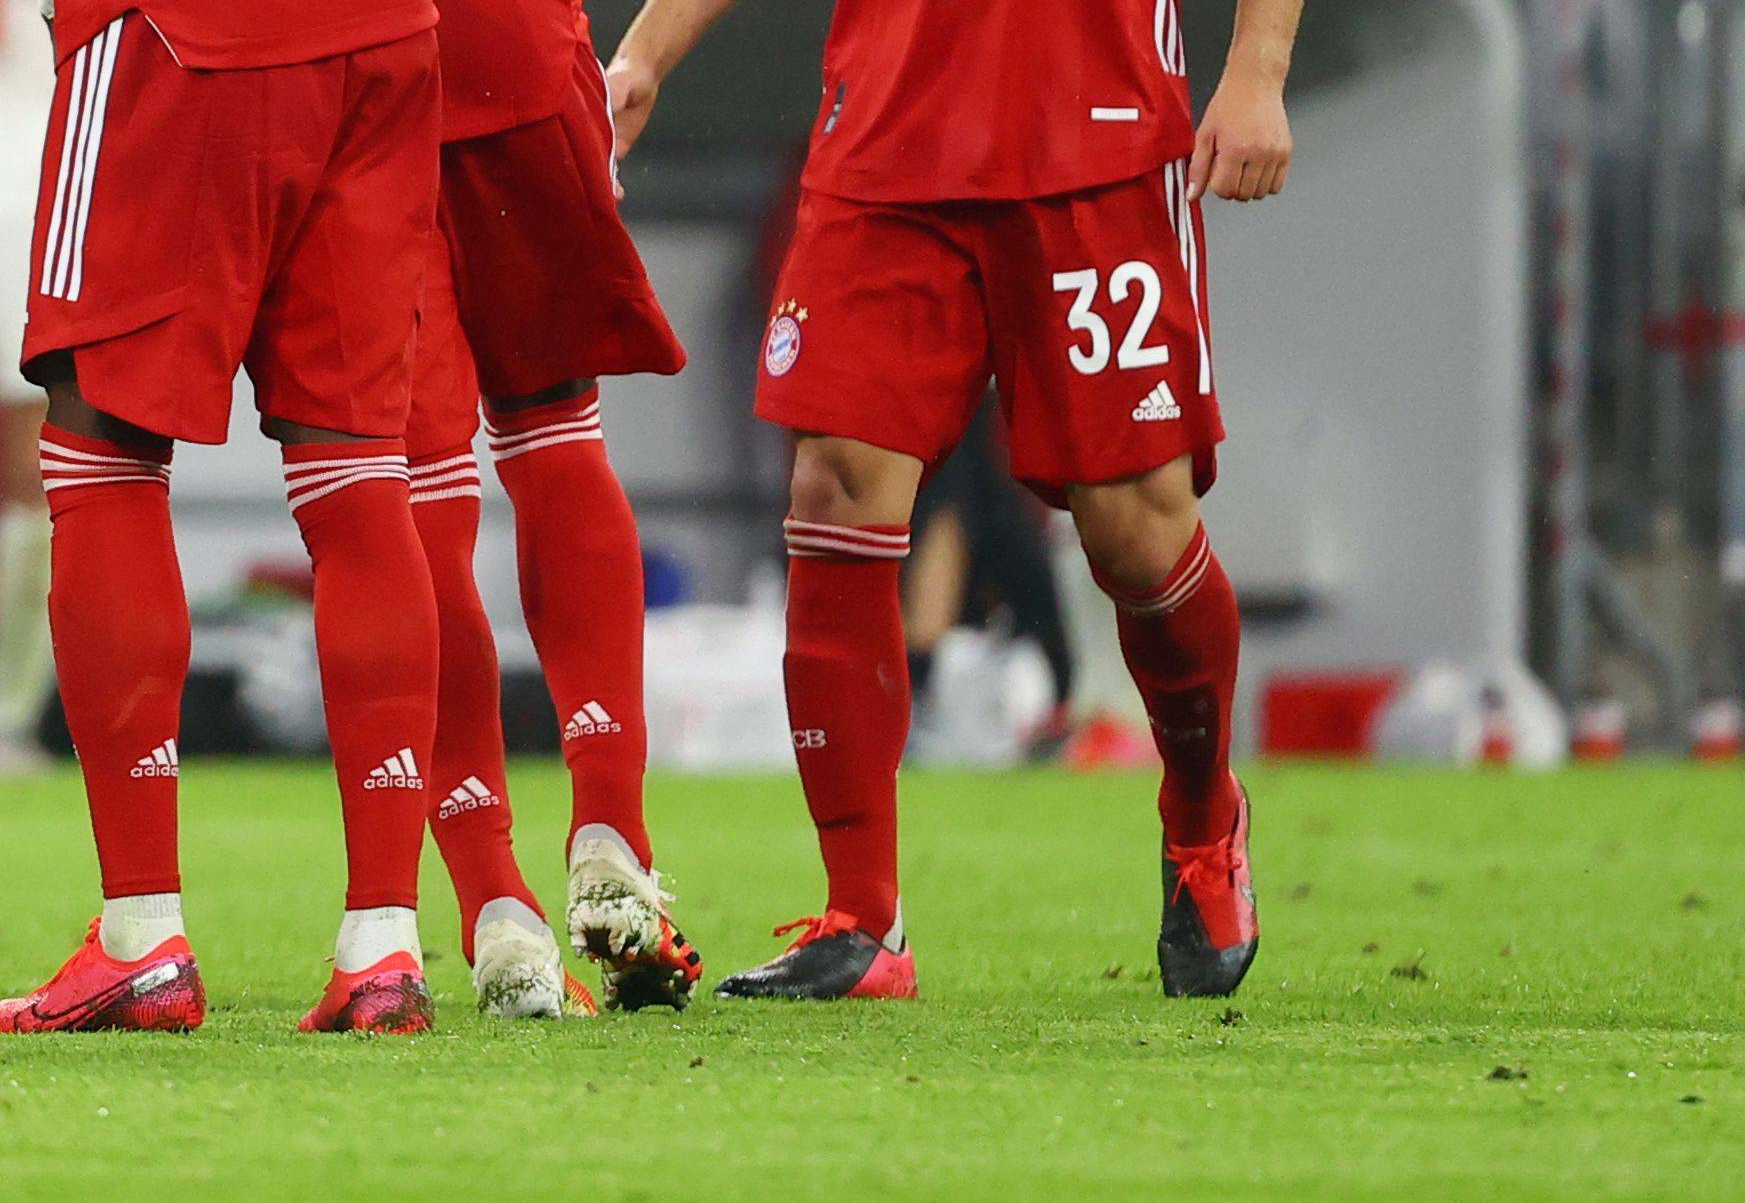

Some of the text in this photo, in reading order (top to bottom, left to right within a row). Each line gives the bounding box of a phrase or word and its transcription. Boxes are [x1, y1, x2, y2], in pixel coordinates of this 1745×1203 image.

[1052, 260, 1170, 375] 32
[1131, 404, 1182, 422] adidas
[563, 721, 622, 742] adidas
[792, 728, 827, 749] CB
[129, 763, 180, 778] adida
[363, 773, 424, 790] adidas
[438, 795, 500, 820] adidas
